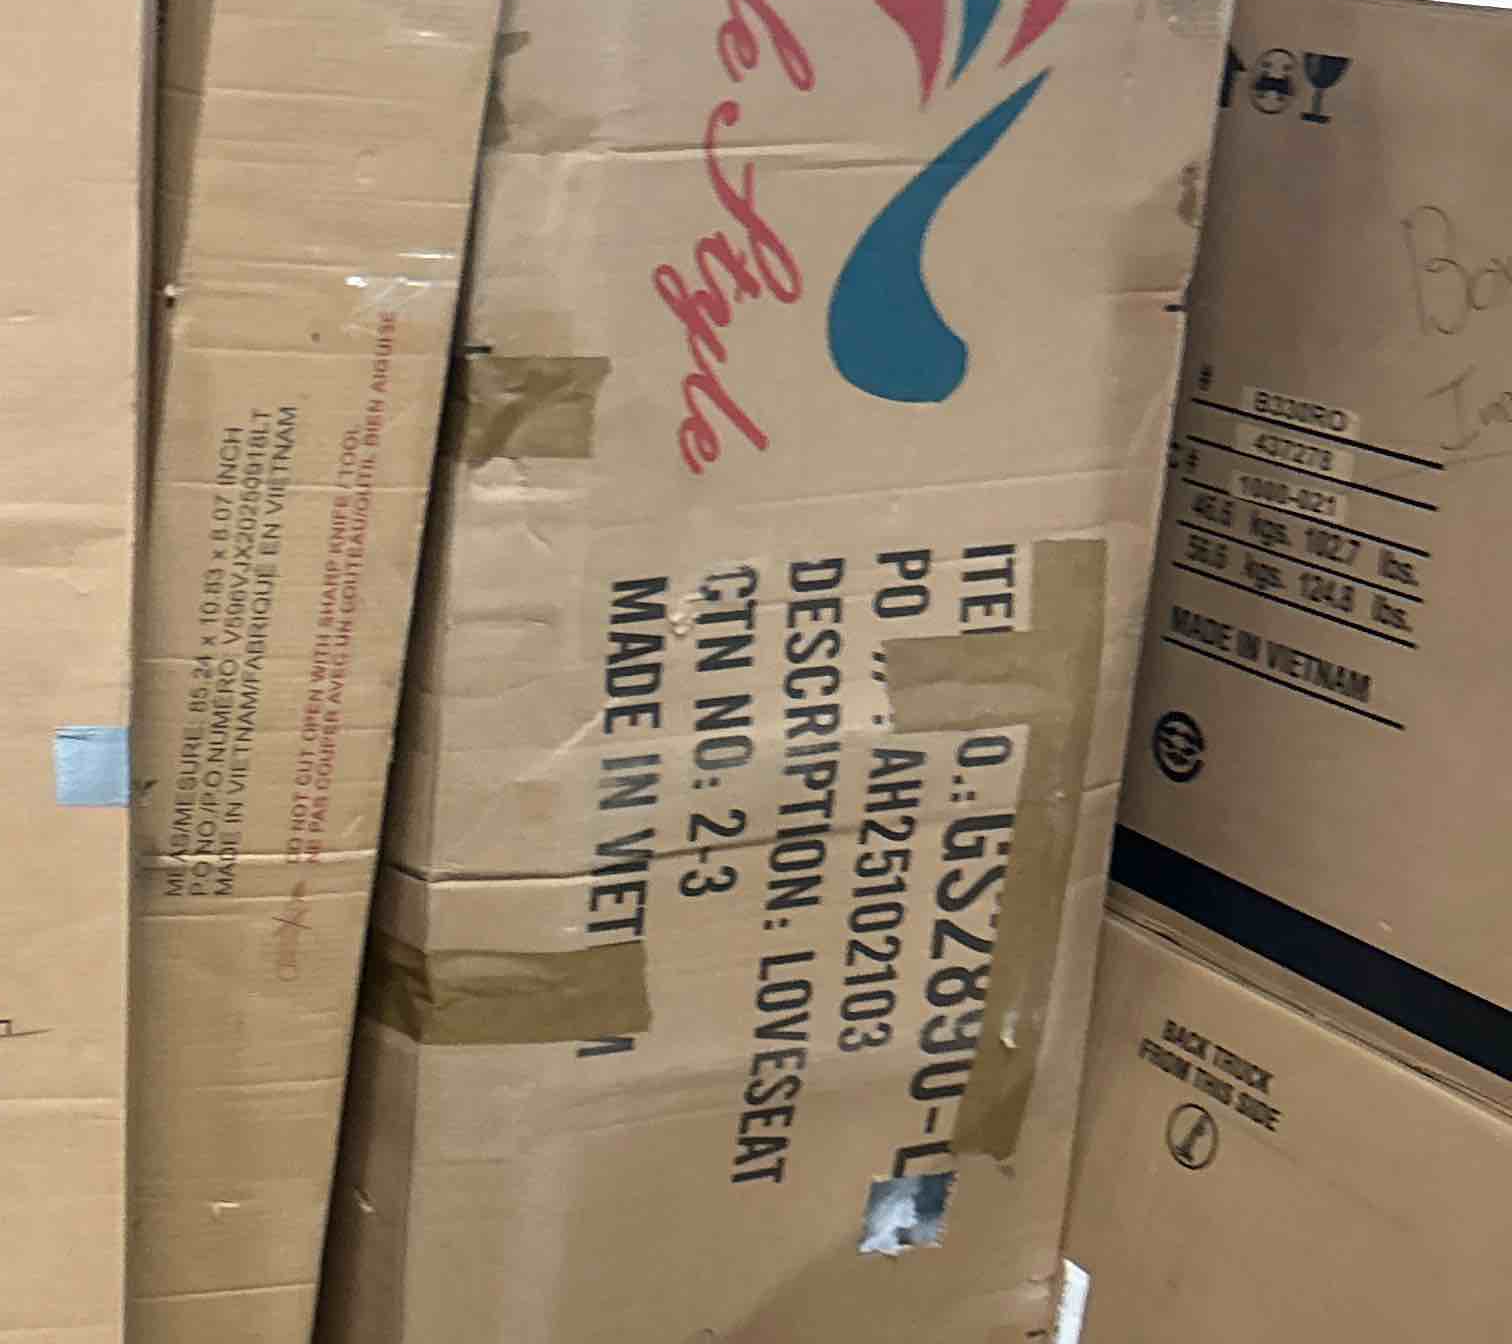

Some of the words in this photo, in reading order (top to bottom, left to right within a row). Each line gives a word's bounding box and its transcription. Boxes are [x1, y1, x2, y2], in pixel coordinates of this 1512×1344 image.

[654, 100, 804, 475] Style
[216, 426, 245, 487] INCH
[262, 406, 298, 516] VIETNAM
[257, 523, 282, 556] EN
[327, 494, 348, 555] KNIFE
[315, 560, 341, 627] SHARP
[872, 548, 932, 619] PO
[960, 544, 1016, 636] ITE
[335, 620, 355, 647] UN
[694, 565, 759, 673] CTN
[308, 634, 332, 683] WITH
[324, 652, 349, 705] AVEC
[603, 576, 670, 736] MADE
[1170, 605, 1233, 652] MADE
[1236, 628, 1261, 660] IN
[1266, 639, 1374, 704] VIETNAM
[299, 689, 326, 743] OPEN
[692, 695, 756, 791] NO:
[763, 557, 846, 931] DESCRIPTION:
[295, 749, 317, 787] CUT
[313, 710, 342, 791] COUPER
[597, 752, 661, 810] IN
[224, 801, 246, 825] IN
[289, 792, 310, 832] NOT
[308, 796, 330, 832] PAS
[213, 830, 239, 896] MADE
[679, 809, 748, 899] 2-3
[837, 746, 926, 1054] AH25102103
[731, 949, 814, 1185] LOVESEAT
